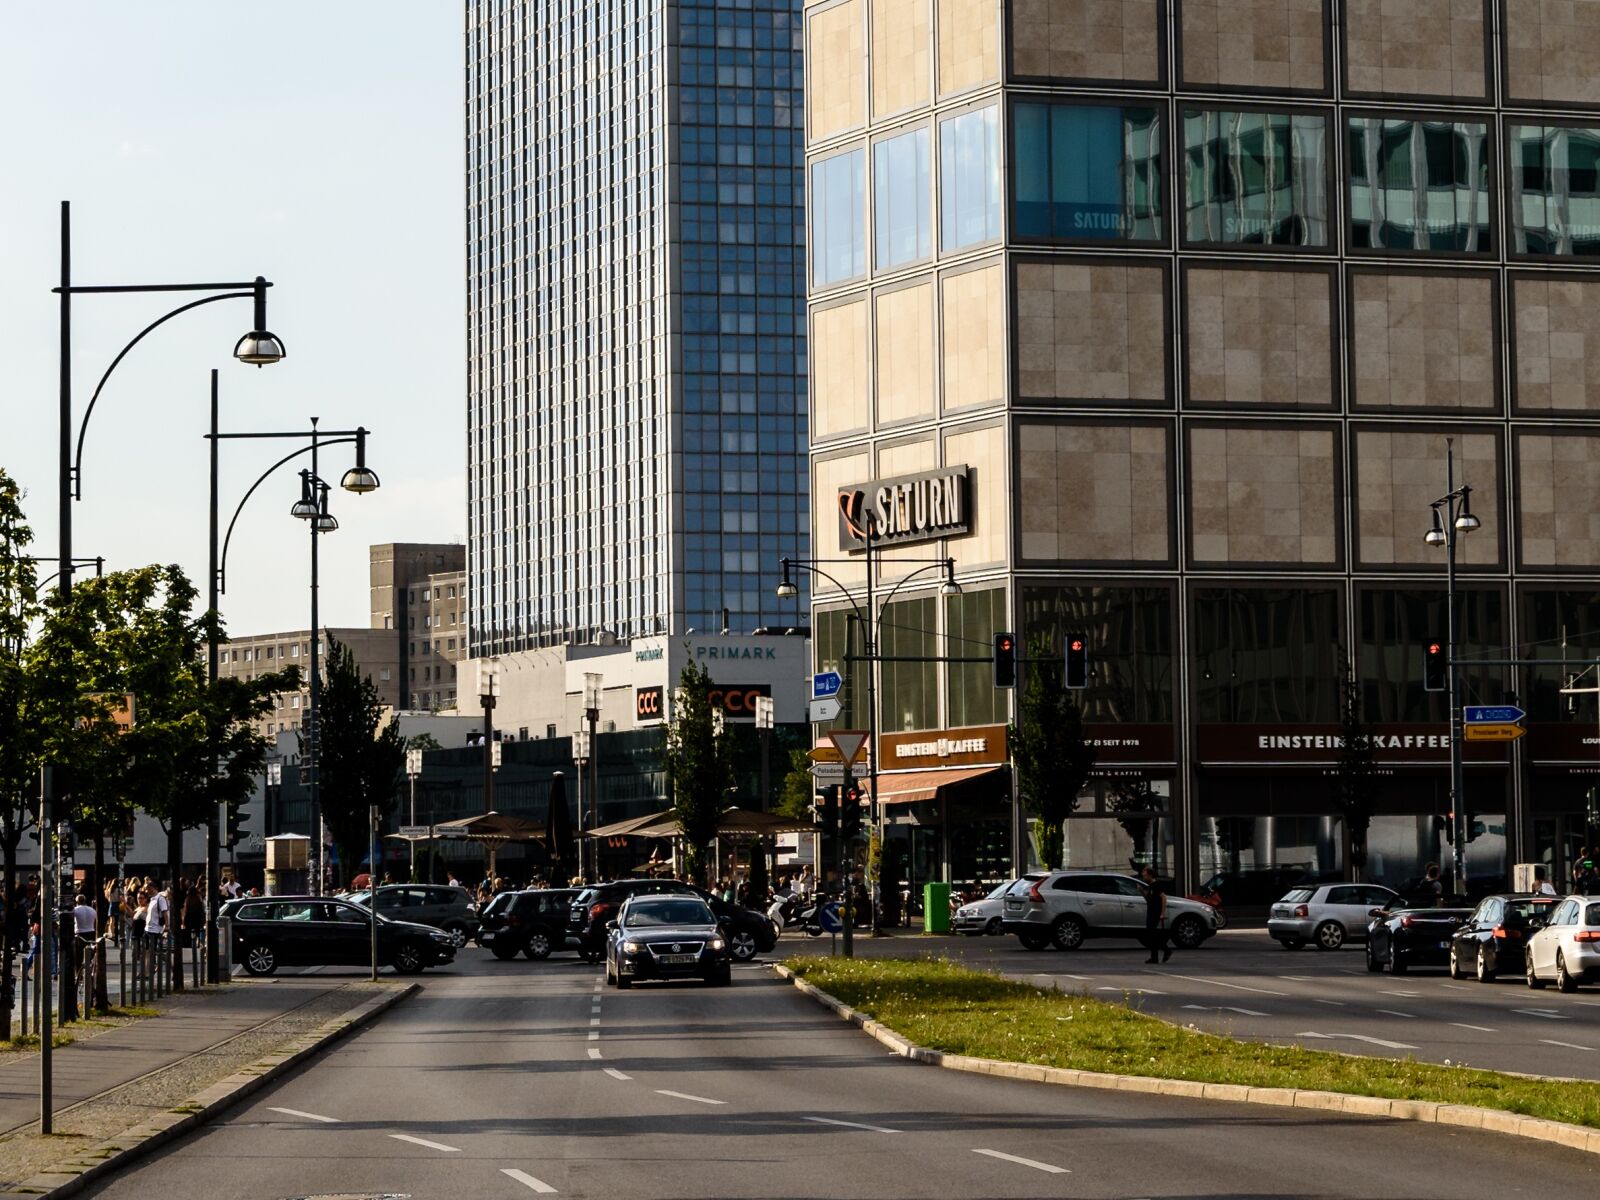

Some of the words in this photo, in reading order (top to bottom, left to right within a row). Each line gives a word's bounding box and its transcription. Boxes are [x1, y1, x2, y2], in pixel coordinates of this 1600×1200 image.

[1073, 211, 1132, 230] SATURN
[876, 474, 959, 536] SATURN
[636, 647, 664, 662] PRIMARK
[697, 647, 776, 659] PRIMARK
[638, 691, 658, 714] CCC
[896, 742, 938, 757] EINSTEIN
[948, 738, 986, 753] KAFFEE
[1258, 735, 1346, 749] EINSTEIN
[1373, 735, 1450, 749] KAFFEE
